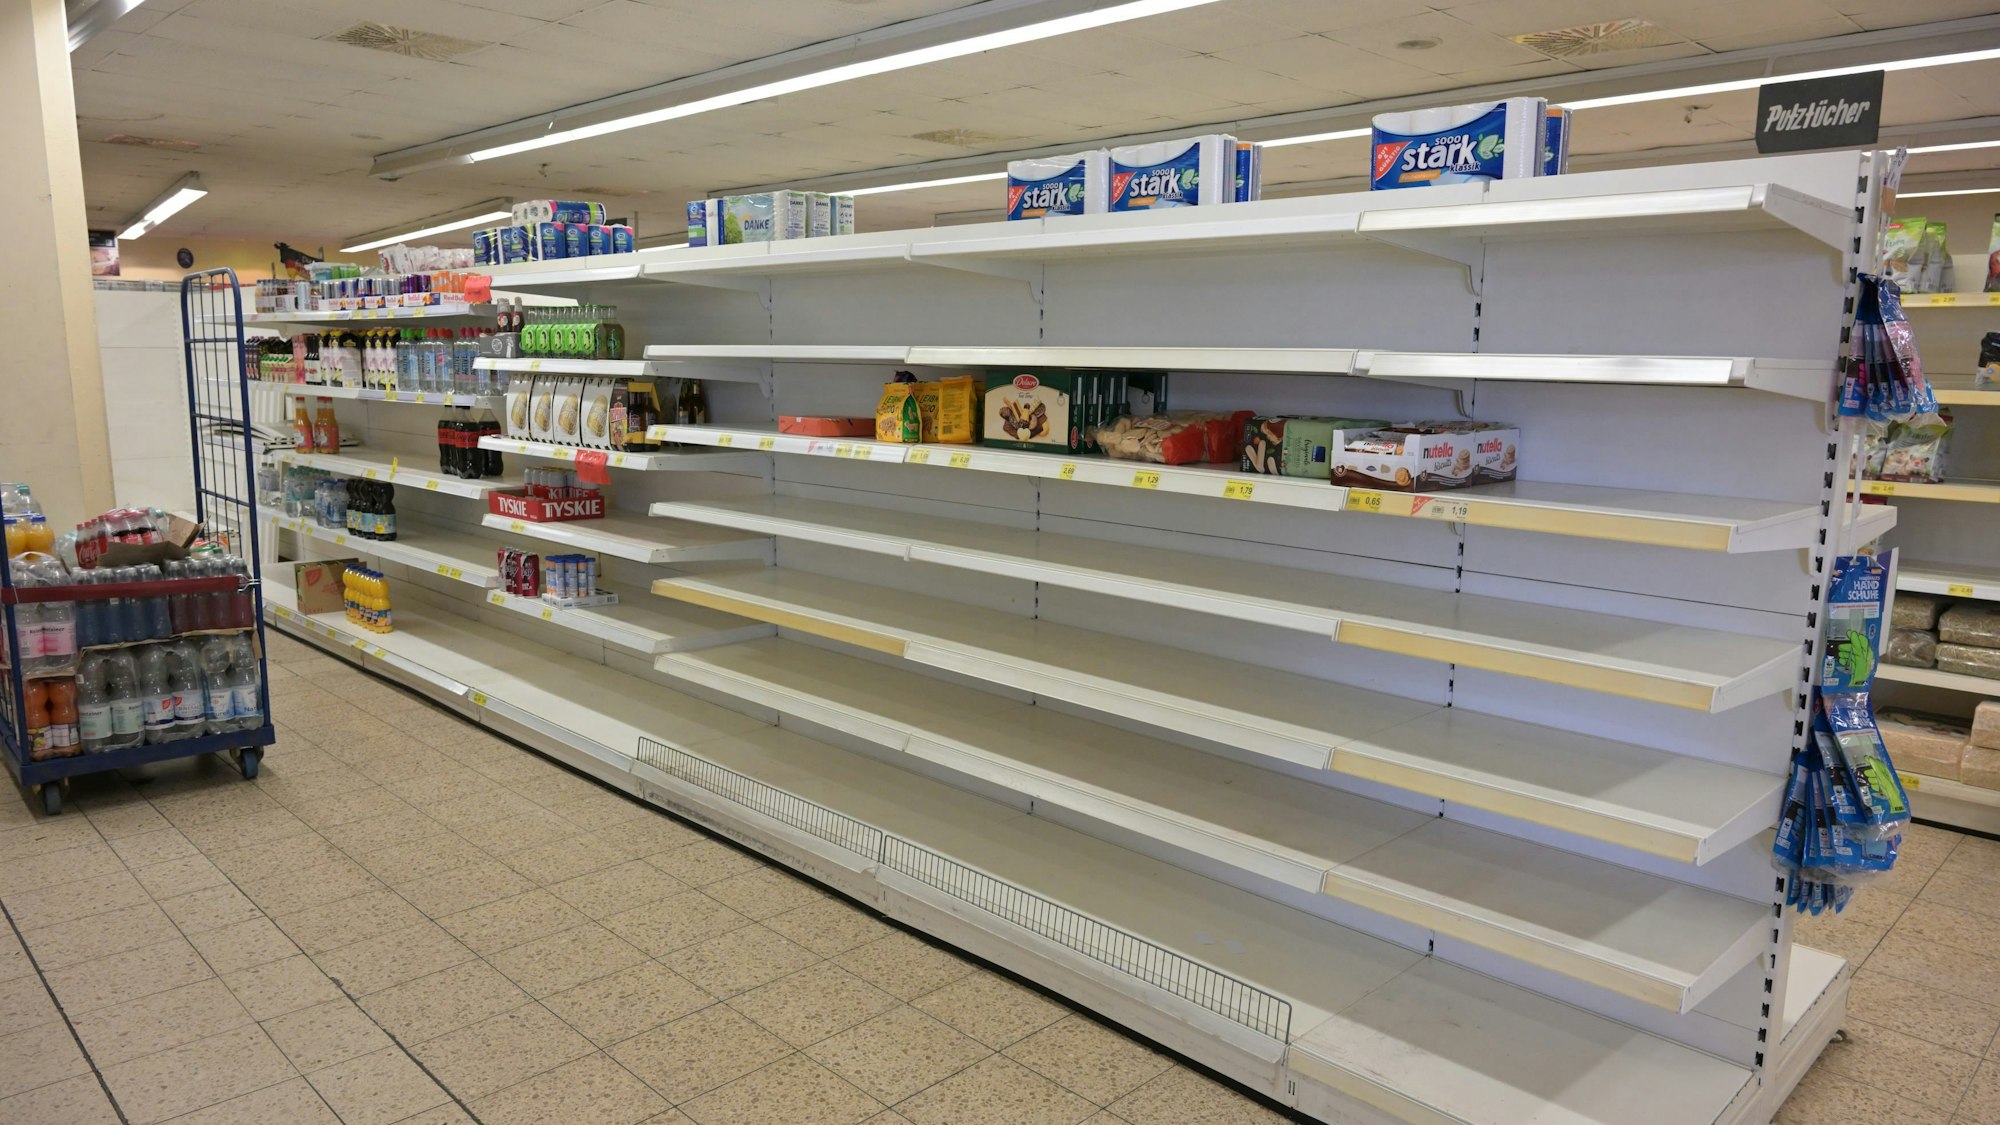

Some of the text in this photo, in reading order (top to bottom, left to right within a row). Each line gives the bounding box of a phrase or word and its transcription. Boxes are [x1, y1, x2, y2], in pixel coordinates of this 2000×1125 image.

[1764, 98, 1870, 133] Putztücher
[1435, 135, 1461, 146] sooo
[1401, 134, 1478, 172] stark
[1450, 161, 1482, 173] klassik
[1129, 167, 1181, 198] stark
[1022, 182, 1069, 209] stark
[744, 219, 770, 231] DANKE
[1423, 442, 1454, 460] nutella
[1476, 437, 1503, 454] nutella
[498, 496, 528, 517] TYSKIE
[541, 499, 601, 518] TYSKIE
[1452, 506, 1468, 516] 1,19
[1853, 580, 1880, 590] HAND
[1847, 590, 1879, 600] SCHUHE
